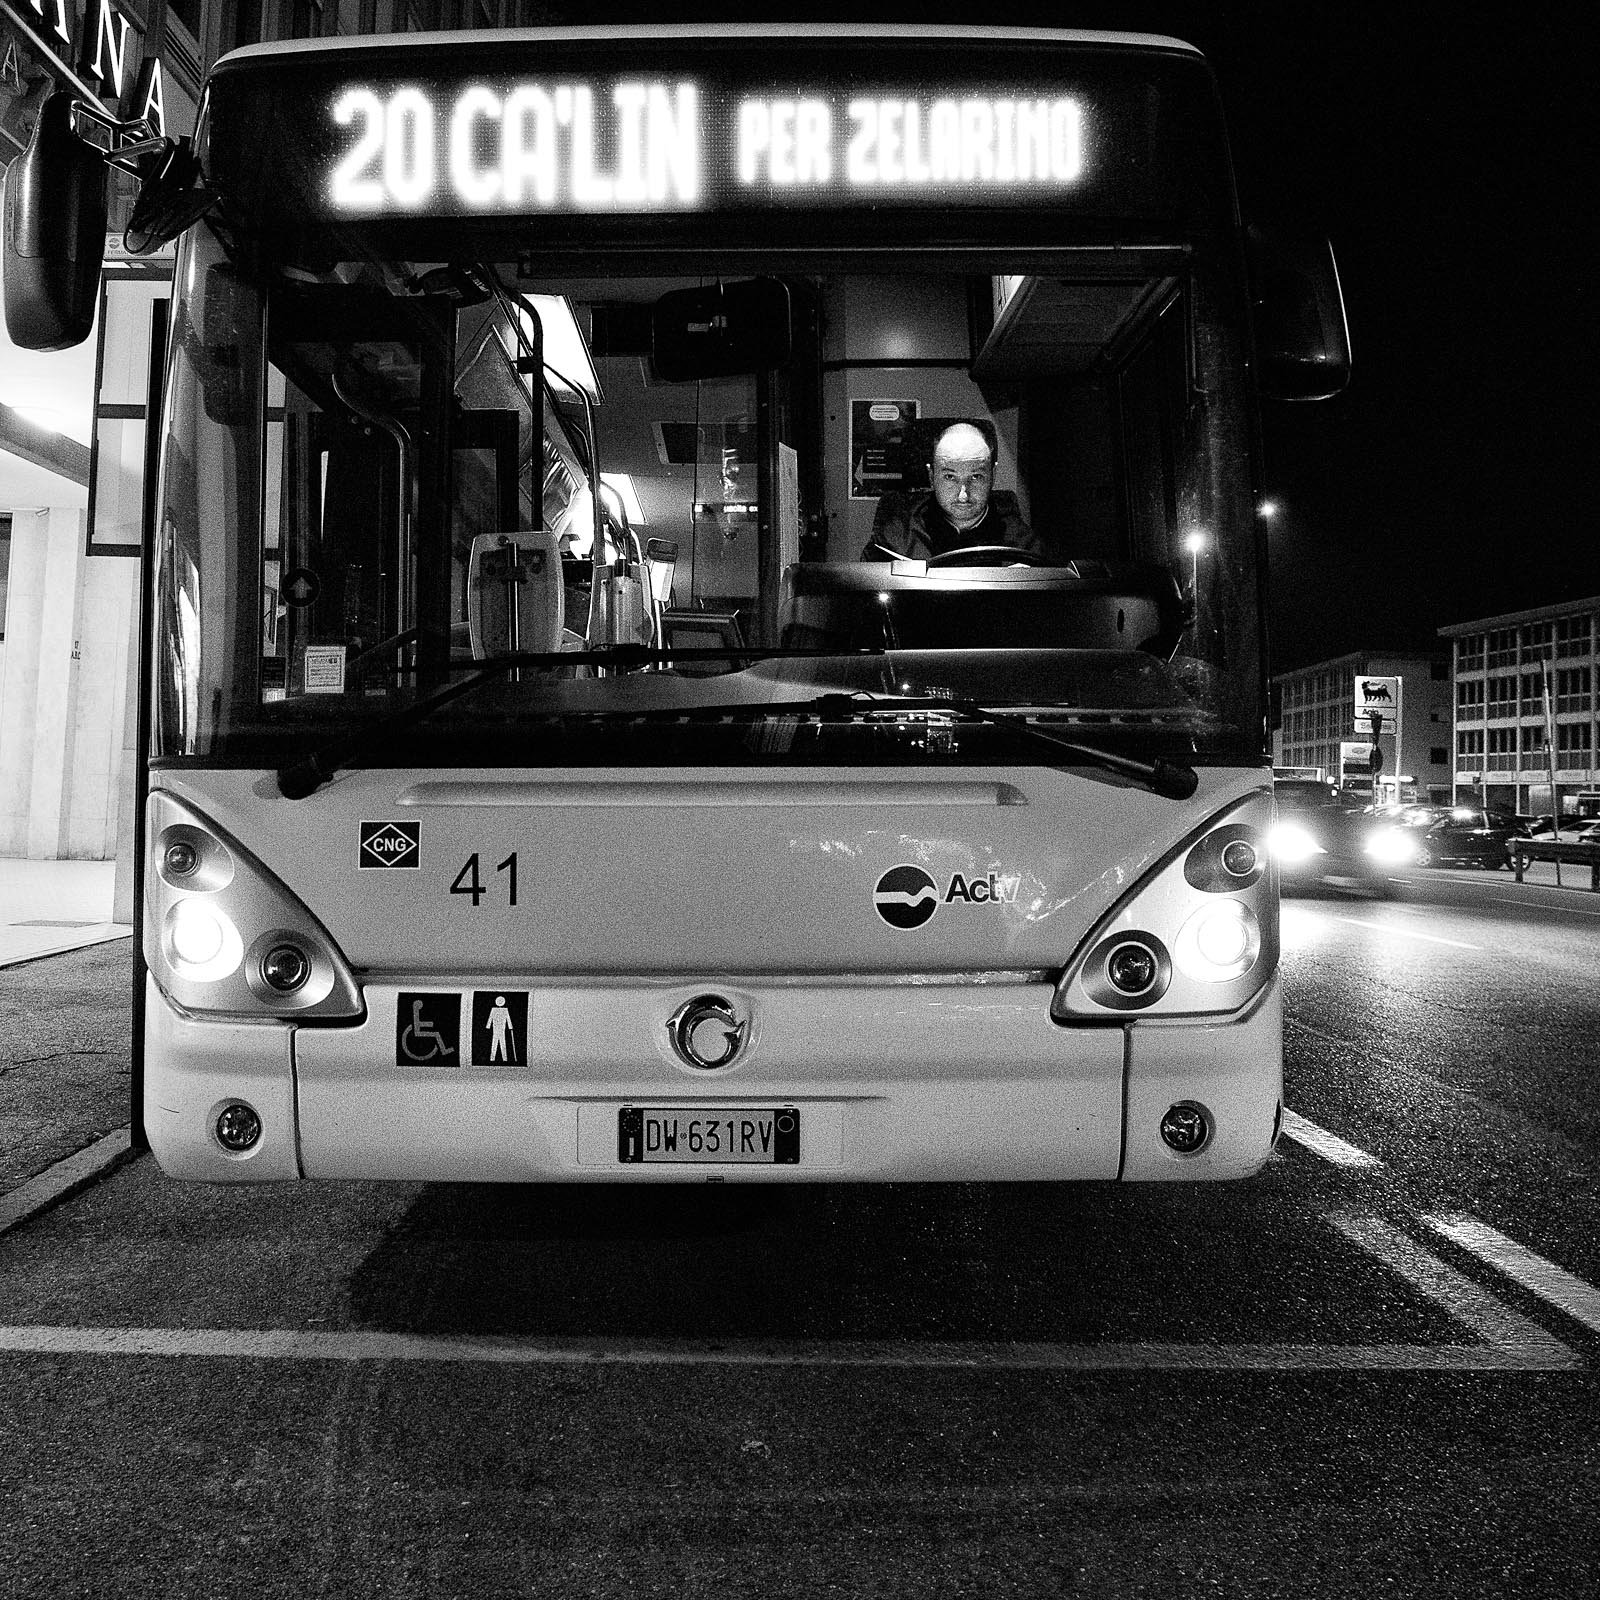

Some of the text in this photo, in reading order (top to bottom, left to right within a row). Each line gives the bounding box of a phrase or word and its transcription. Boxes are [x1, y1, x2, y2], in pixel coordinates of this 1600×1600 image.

[333, 83, 697, 208] 20 CA'LIN
[738, 99, 1081, 184] PER ZELARINO
[372, 837, 407, 853] CNG
[449, 852, 517, 906] 41
